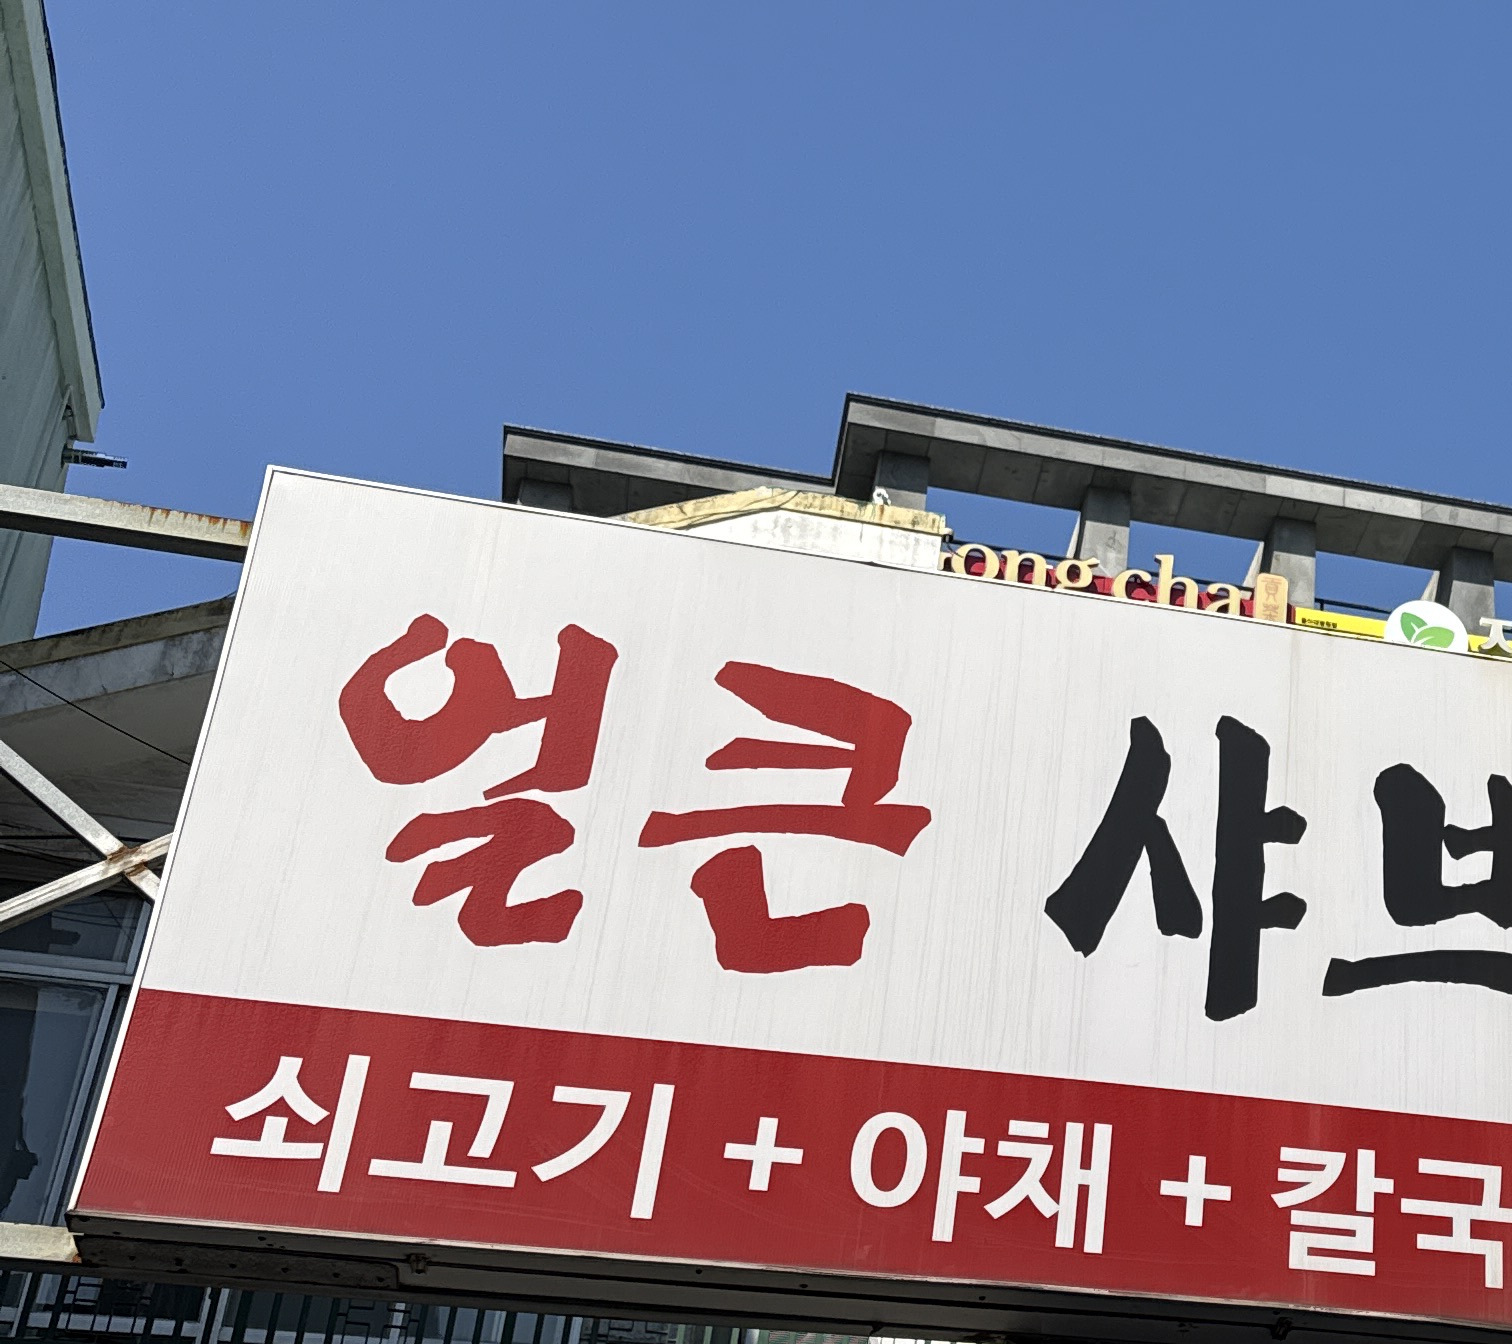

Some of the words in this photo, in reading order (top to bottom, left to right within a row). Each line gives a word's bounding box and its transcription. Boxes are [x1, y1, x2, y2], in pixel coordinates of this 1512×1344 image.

[938, 543, 1100, 592] ong
[339, 613, 931, 974] 얼큰
[210, 1054, 674, 1220] 쇠고기
[850, 1109, 1113, 1254] 야채
